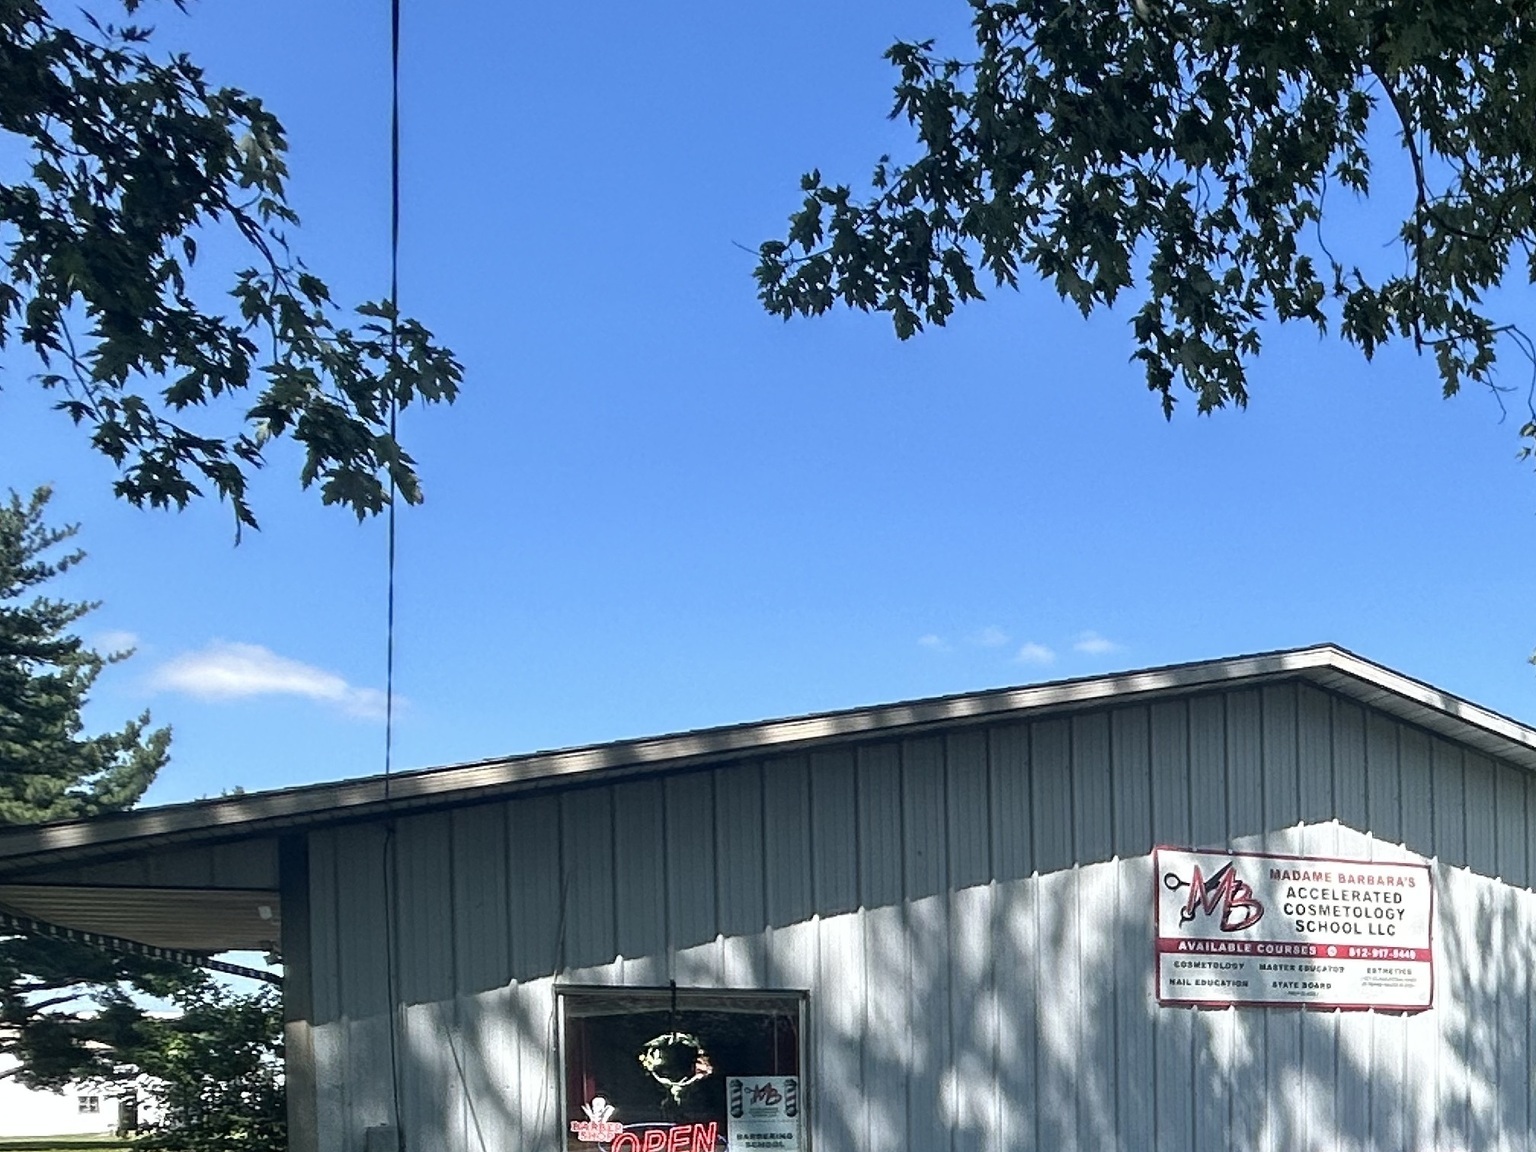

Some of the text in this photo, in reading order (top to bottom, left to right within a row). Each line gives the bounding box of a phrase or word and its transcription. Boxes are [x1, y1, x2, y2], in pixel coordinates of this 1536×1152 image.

[1269, 869, 1416, 888] MADAME BARBARA'S
[1286, 887, 1402, 903] ACCELERATED
[1284, 903, 1405, 920] COSMETOLOGY
[1295, 920, 1396, 936] SCHOOL LLC
[1178, 941, 1316, 956] AVAILABLE COURSES
[1174, 961, 1244, 969] COSMETOLOGY
[1299, 965, 1344, 973] EDUCATOR
[1169, 978, 1248, 987] NAIL EDUCATION
[1272, 981, 1299, 989] STATE
